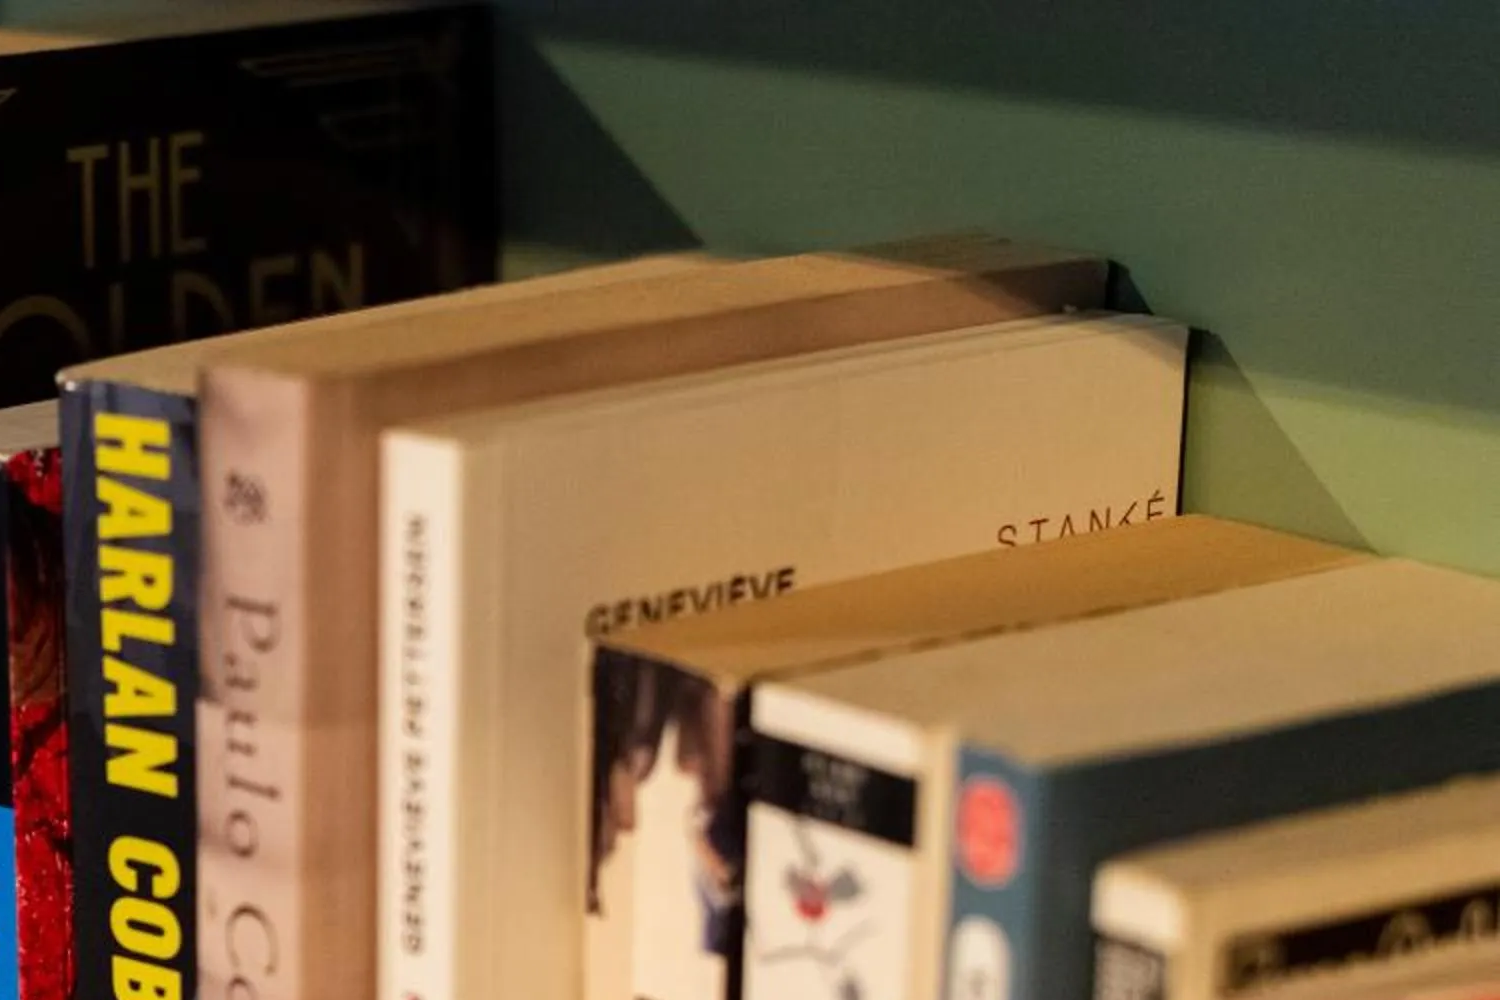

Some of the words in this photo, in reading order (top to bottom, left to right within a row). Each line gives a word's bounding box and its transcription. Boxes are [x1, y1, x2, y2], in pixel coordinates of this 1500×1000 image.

[66, 131, 209, 270] THE
[94, 410, 179, 799] HARLAN
[222, 594, 283, 861] Paulo
